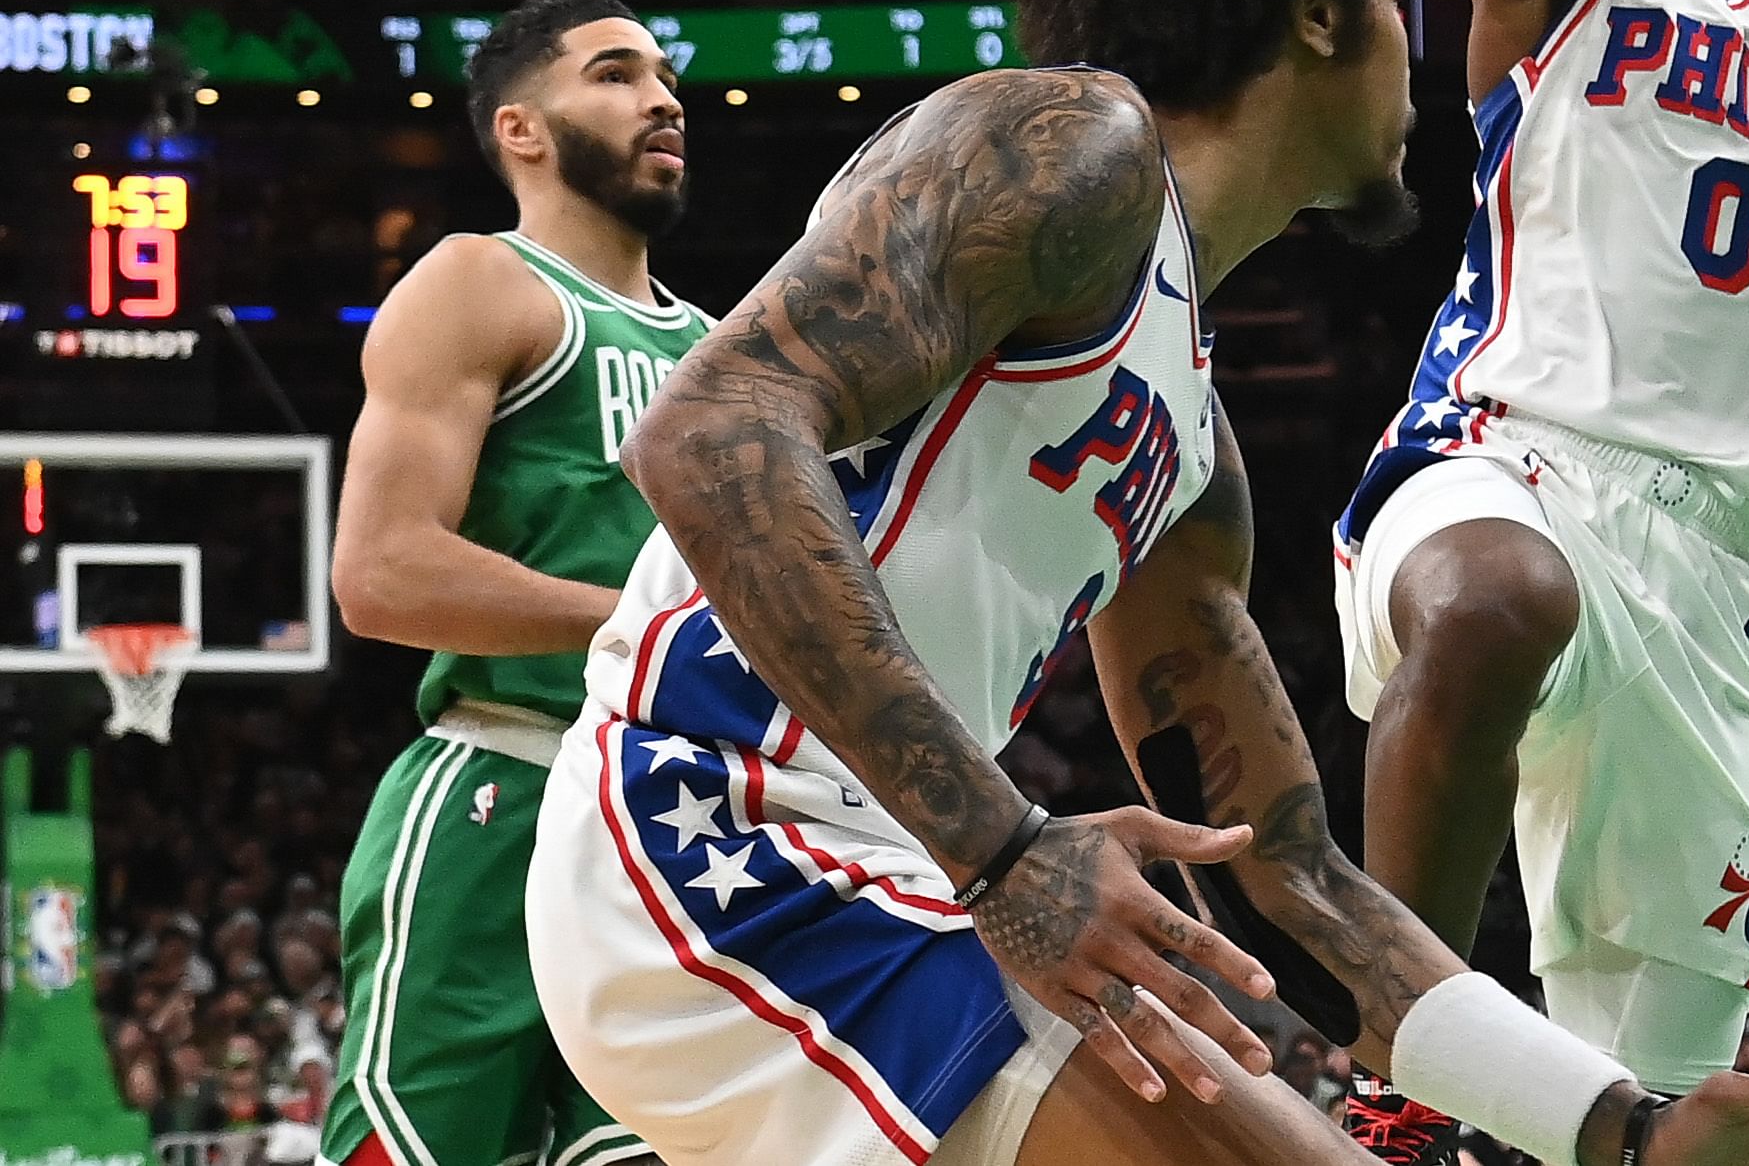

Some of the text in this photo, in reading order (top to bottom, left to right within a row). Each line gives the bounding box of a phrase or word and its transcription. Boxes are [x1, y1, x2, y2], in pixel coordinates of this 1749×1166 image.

[975, 30, 1003, 68] 0
[73, 175, 188, 229] 7:53
[90, 227, 179, 318] 19
